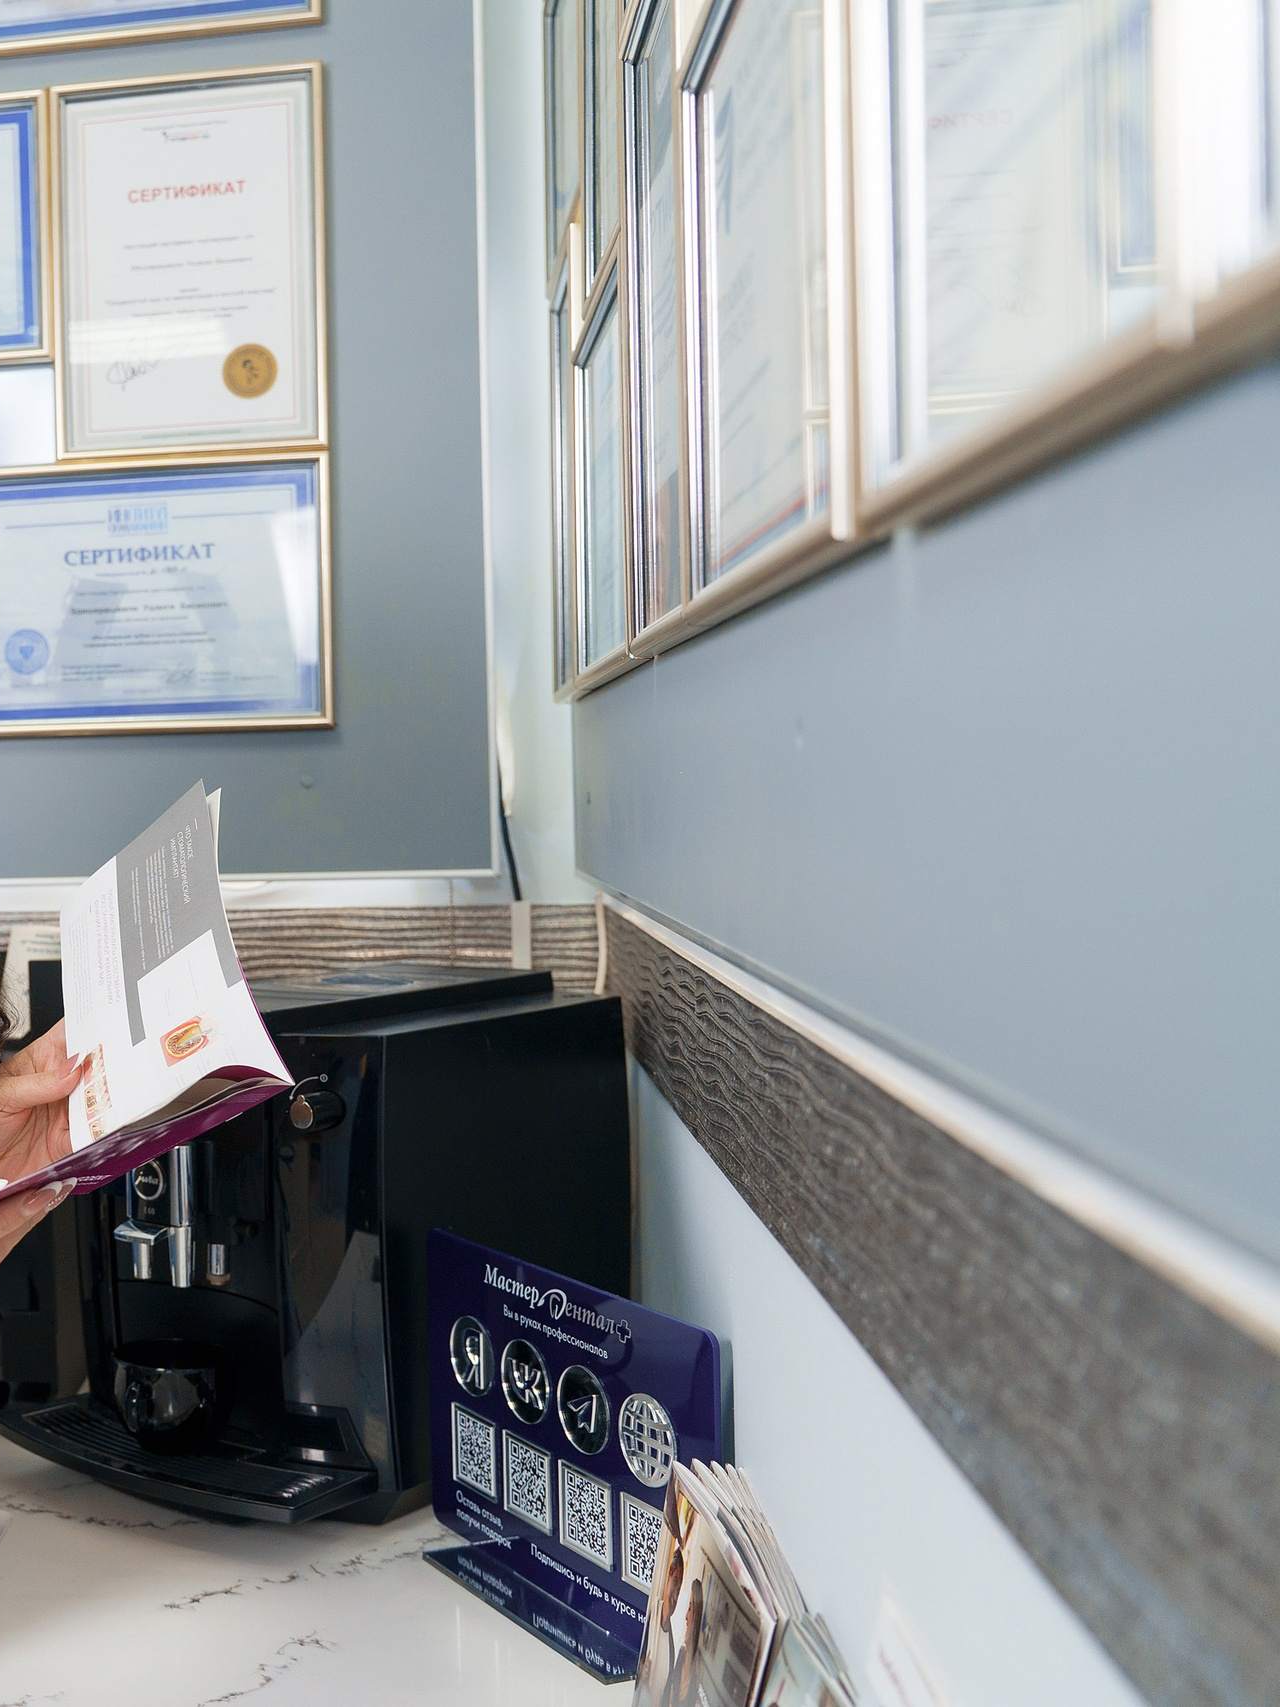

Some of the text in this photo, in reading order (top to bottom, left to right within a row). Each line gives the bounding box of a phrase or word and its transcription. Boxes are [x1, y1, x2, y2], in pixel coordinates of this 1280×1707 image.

[127, 179, 247, 204] СЕРТИФИКАТ
[64, 542, 215, 567] СЕРТИФИКАТ
[184, 825, 194, 859] ЧТО ТАКОЕ
[177, 831, 191, 904] СТОМАТОЛОГИЧЕСКИЙ
[134, 1171, 159, 1186] jura
[483, 1264, 540, 1309] Мастер
[503, 1304, 608, 1359] Вы в руках профессионалов
[455, 1489, 504, 1530] Оставь отзыв,
[456, 1508, 512, 1550] получи подарок
[530, 1543, 575, 1585] Подпишись
[576, 1575, 582, 1586] и
[583, 1575, 603, 1599] будь
[604, 1591, 610, 1602] в
[611, 1595, 636, 1618] курсе
